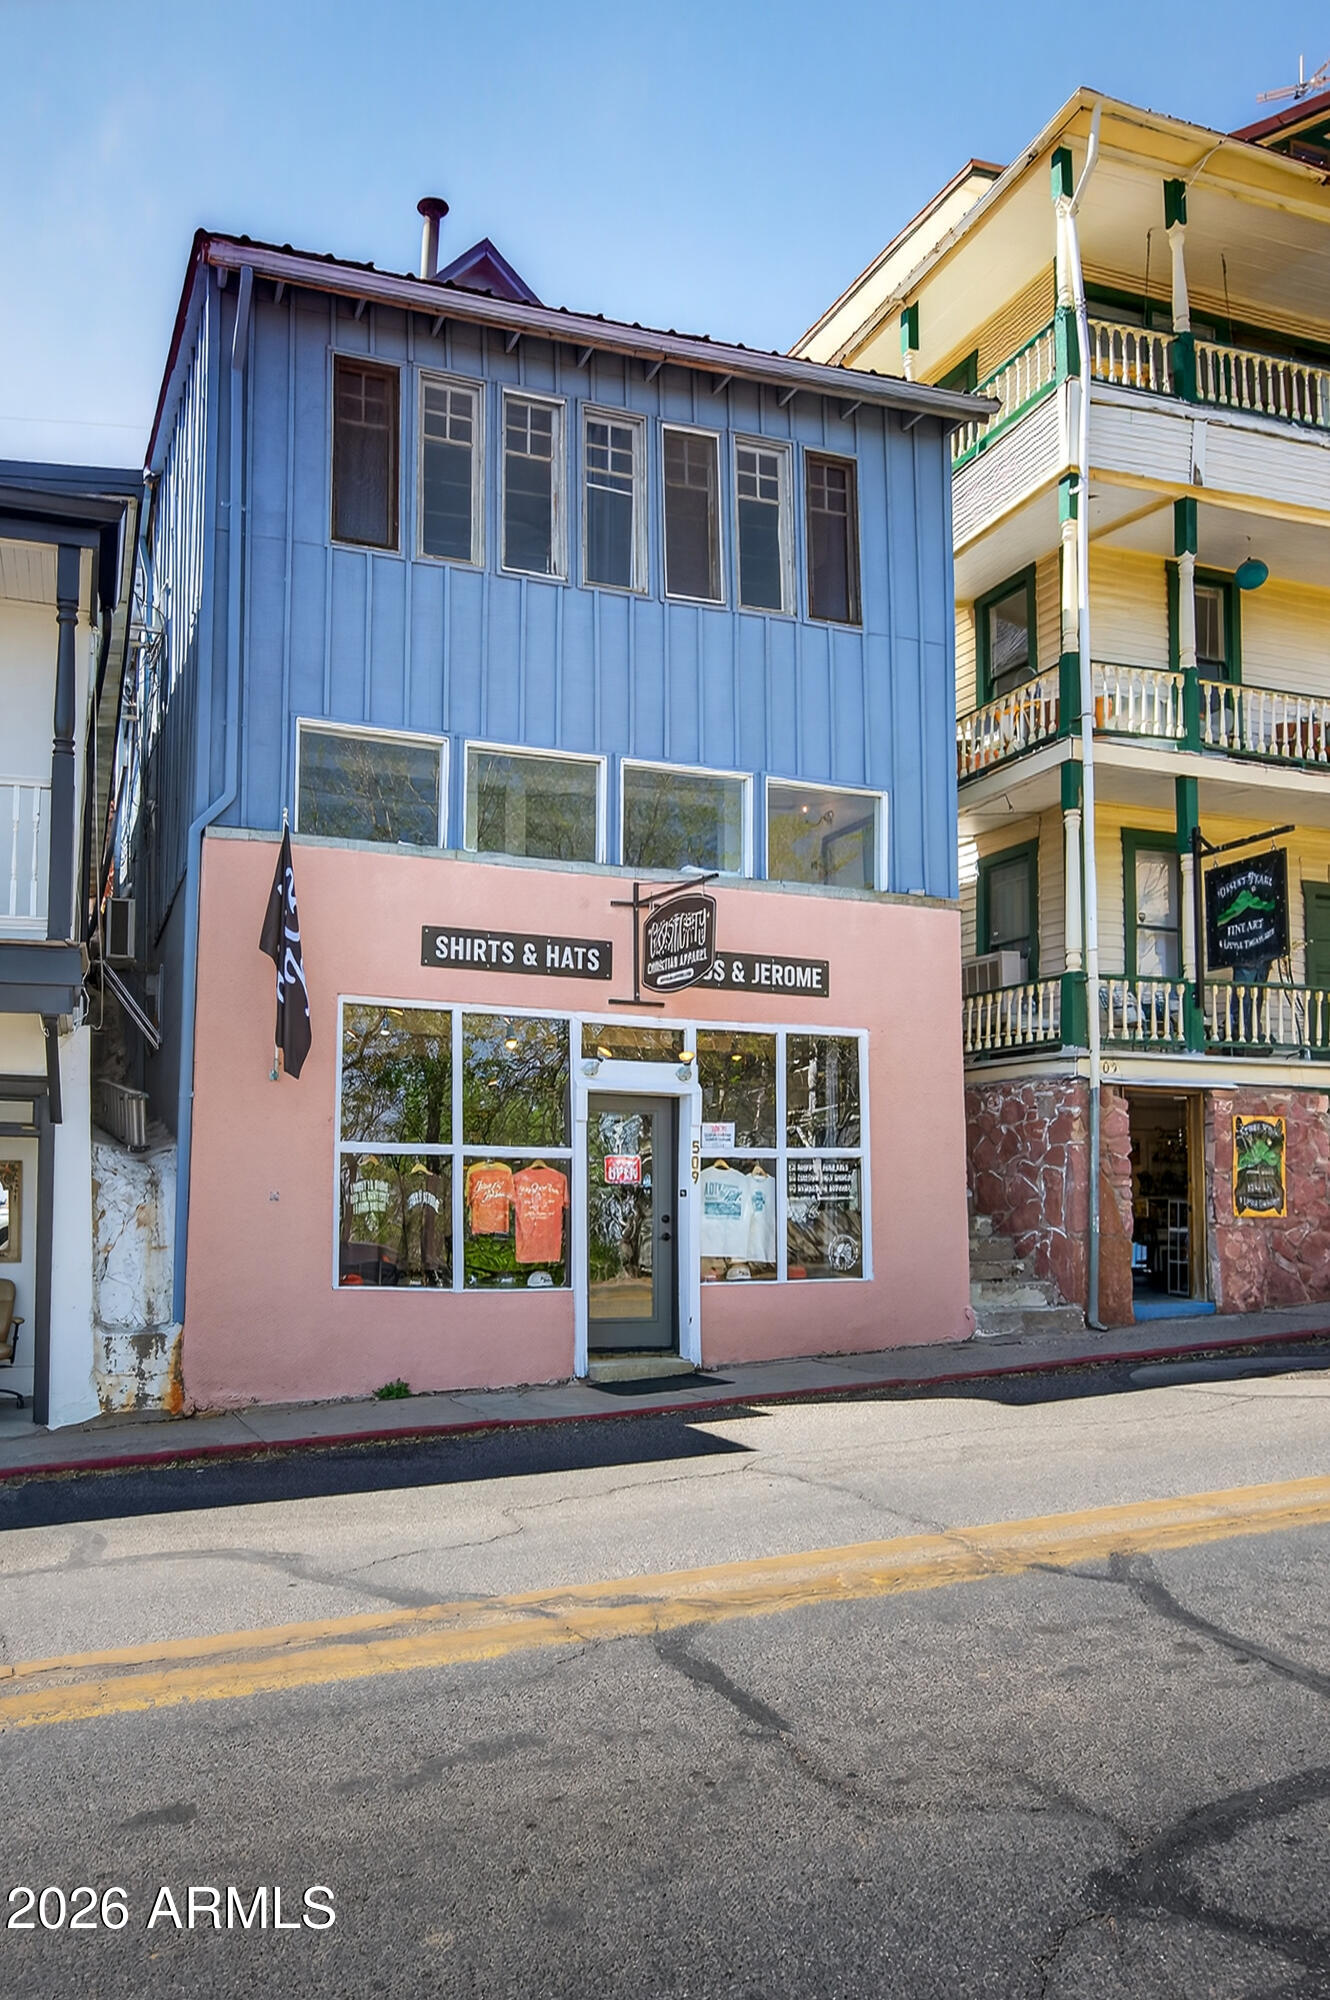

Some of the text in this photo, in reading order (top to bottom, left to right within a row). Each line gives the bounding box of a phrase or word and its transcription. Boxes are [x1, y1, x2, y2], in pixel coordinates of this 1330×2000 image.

[435, 935, 600, 972] SHIRTS & HATS
[731, 960, 746, 983] &
[751, 962, 822, 989] JEROME
[608, 1164, 638, 1181] OPEN
[691, 1140, 700, 1184] 509
